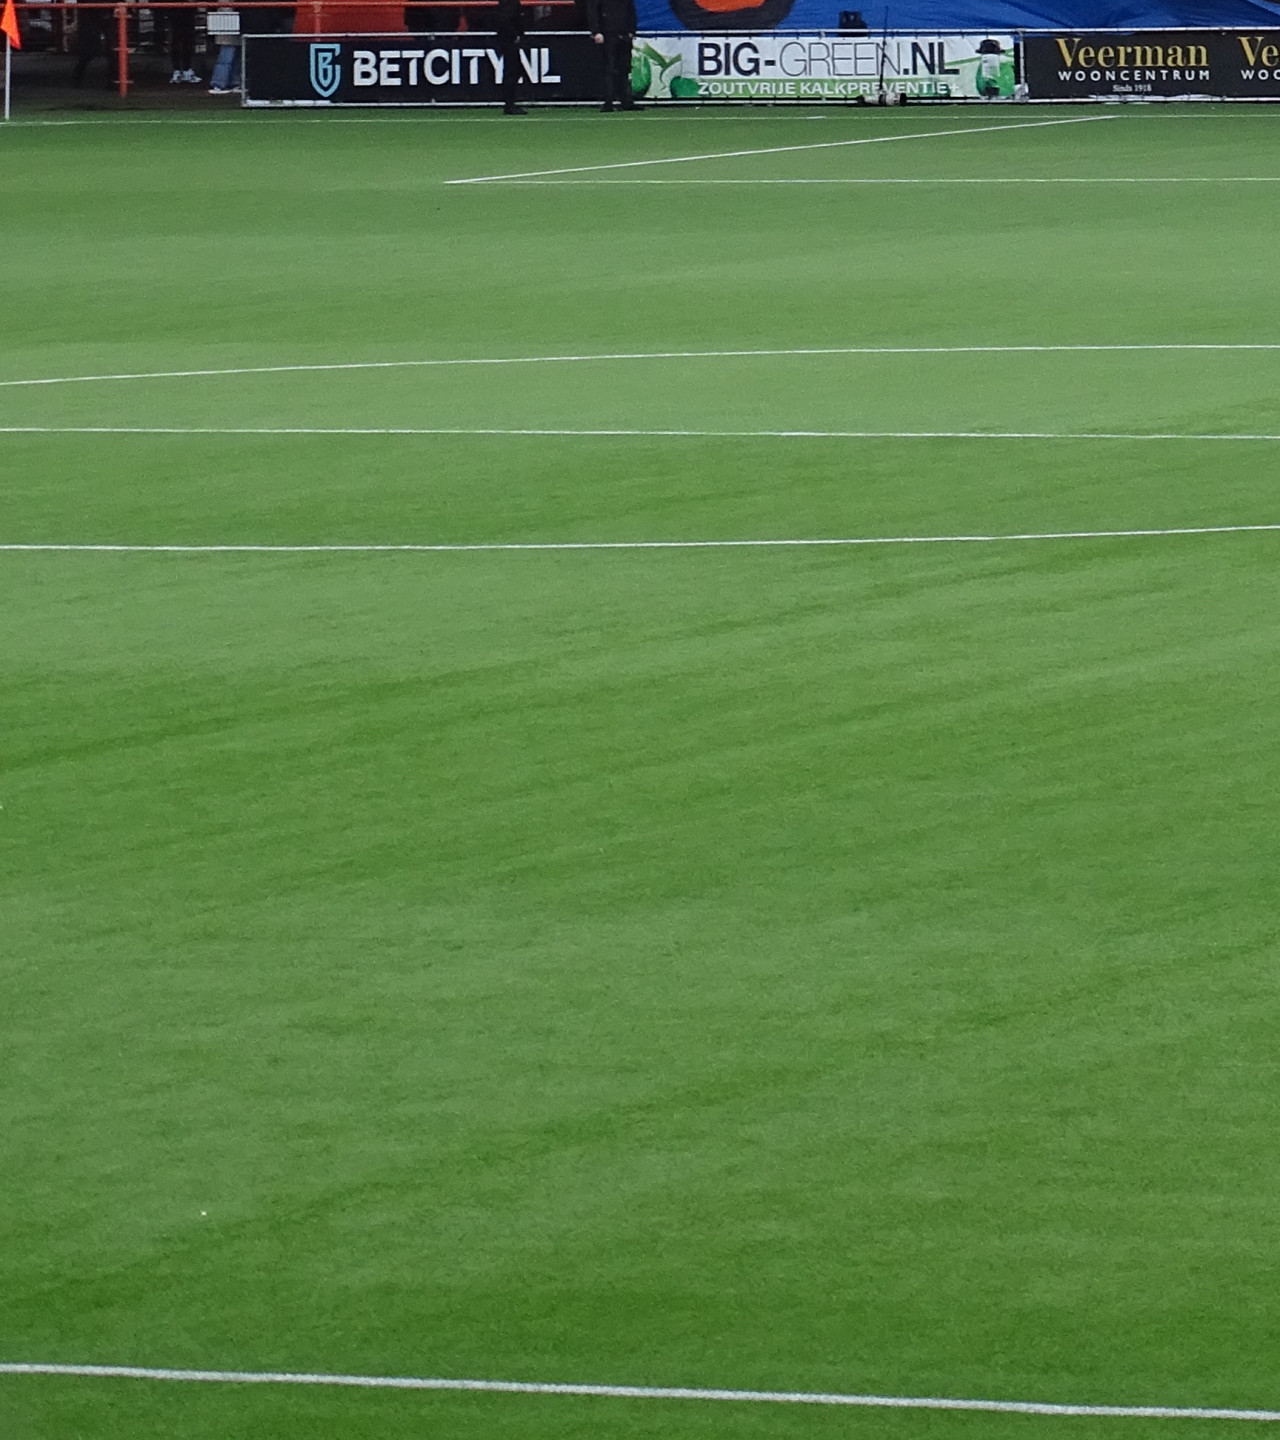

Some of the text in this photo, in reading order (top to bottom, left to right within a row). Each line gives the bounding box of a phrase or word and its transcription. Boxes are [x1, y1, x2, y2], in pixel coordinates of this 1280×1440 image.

[697, 41, 961, 77] BIG-GREEN.NL
[1055, 37, 1210, 68] Veerman
[1057, 69, 1211, 82] WOONCENTRUM
[697, 80, 797, 96] ZOUTVRIJE
